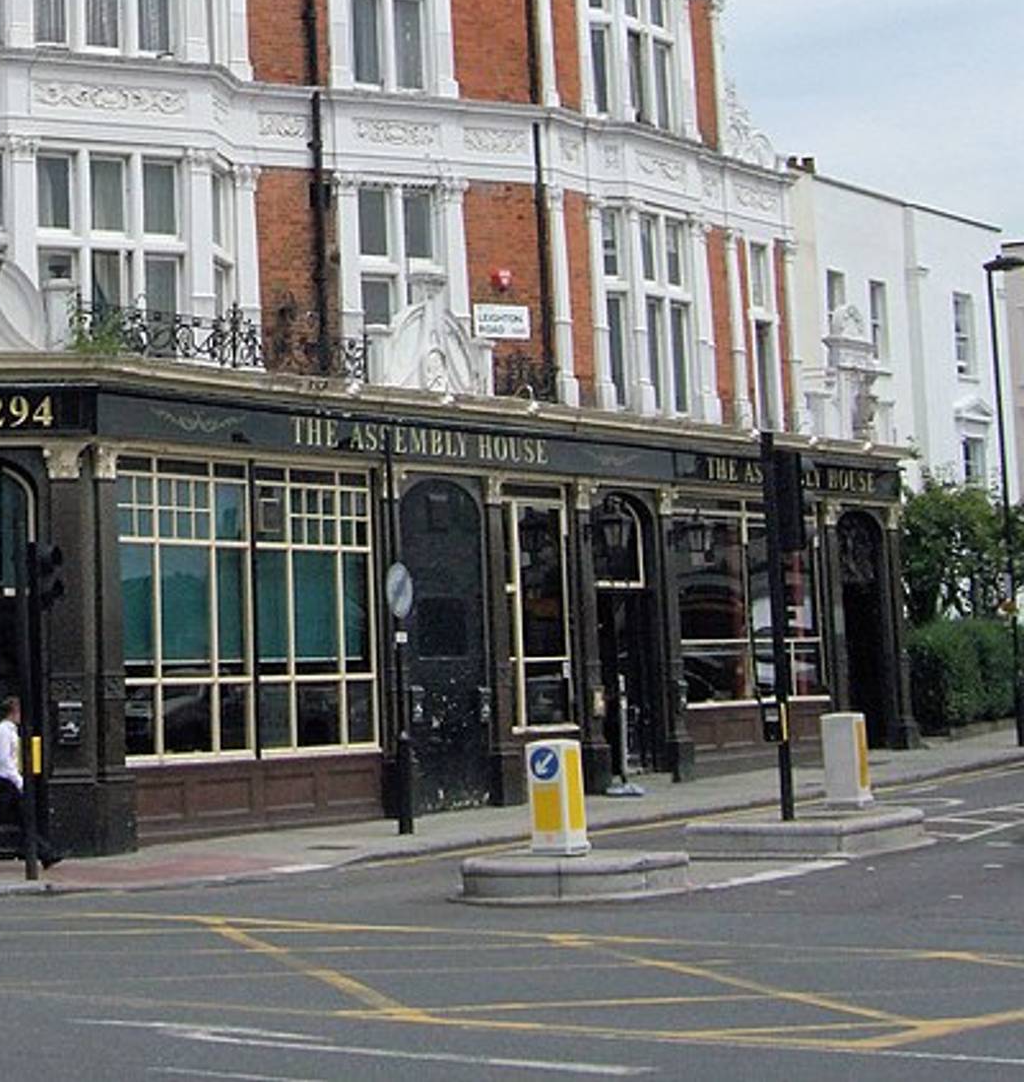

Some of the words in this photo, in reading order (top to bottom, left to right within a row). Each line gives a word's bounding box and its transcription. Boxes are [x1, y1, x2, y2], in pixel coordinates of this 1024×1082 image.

[290, 417, 339, 448] THE
[349, 423, 467, 458] ASSEMBLY
[478, 434, 549, 464] HOUSE
[706, 457, 738, 481] THE
[743, 464, 821, 488] ASLY
[827, 469, 875, 492] HOUSE
